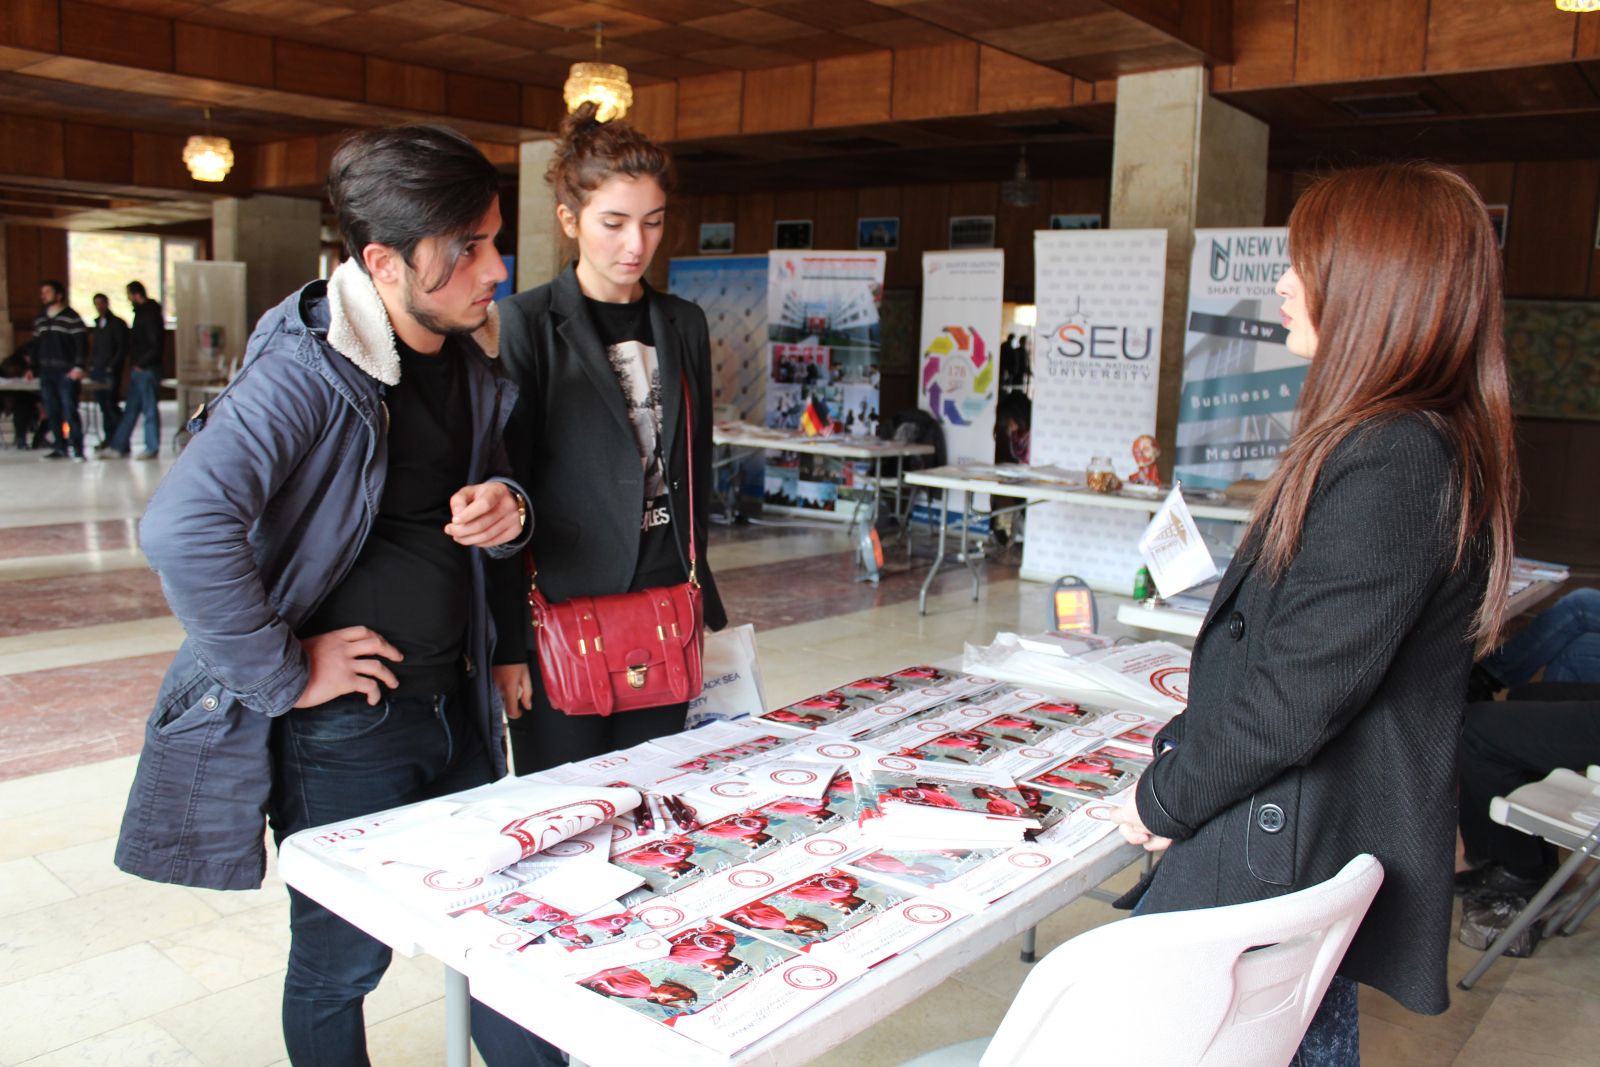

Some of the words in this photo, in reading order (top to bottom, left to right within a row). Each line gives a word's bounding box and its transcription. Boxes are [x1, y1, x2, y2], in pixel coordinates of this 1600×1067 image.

[1235, 236, 1273, 257] NEW
[1207, 286, 1241, 296] SHAPE
[1239, 320, 1274, 338] Law
[1057, 324, 1153, 361] SEU
[1048, 367, 1151, 382] UNIVERSITY
[1190, 389, 1271, 409] Business
[1279, 383, 1291, 398] &
[702, 678, 721, 691] ACK
[722, 672, 742, 685] SEA
[689, 695, 708, 710] SITY
